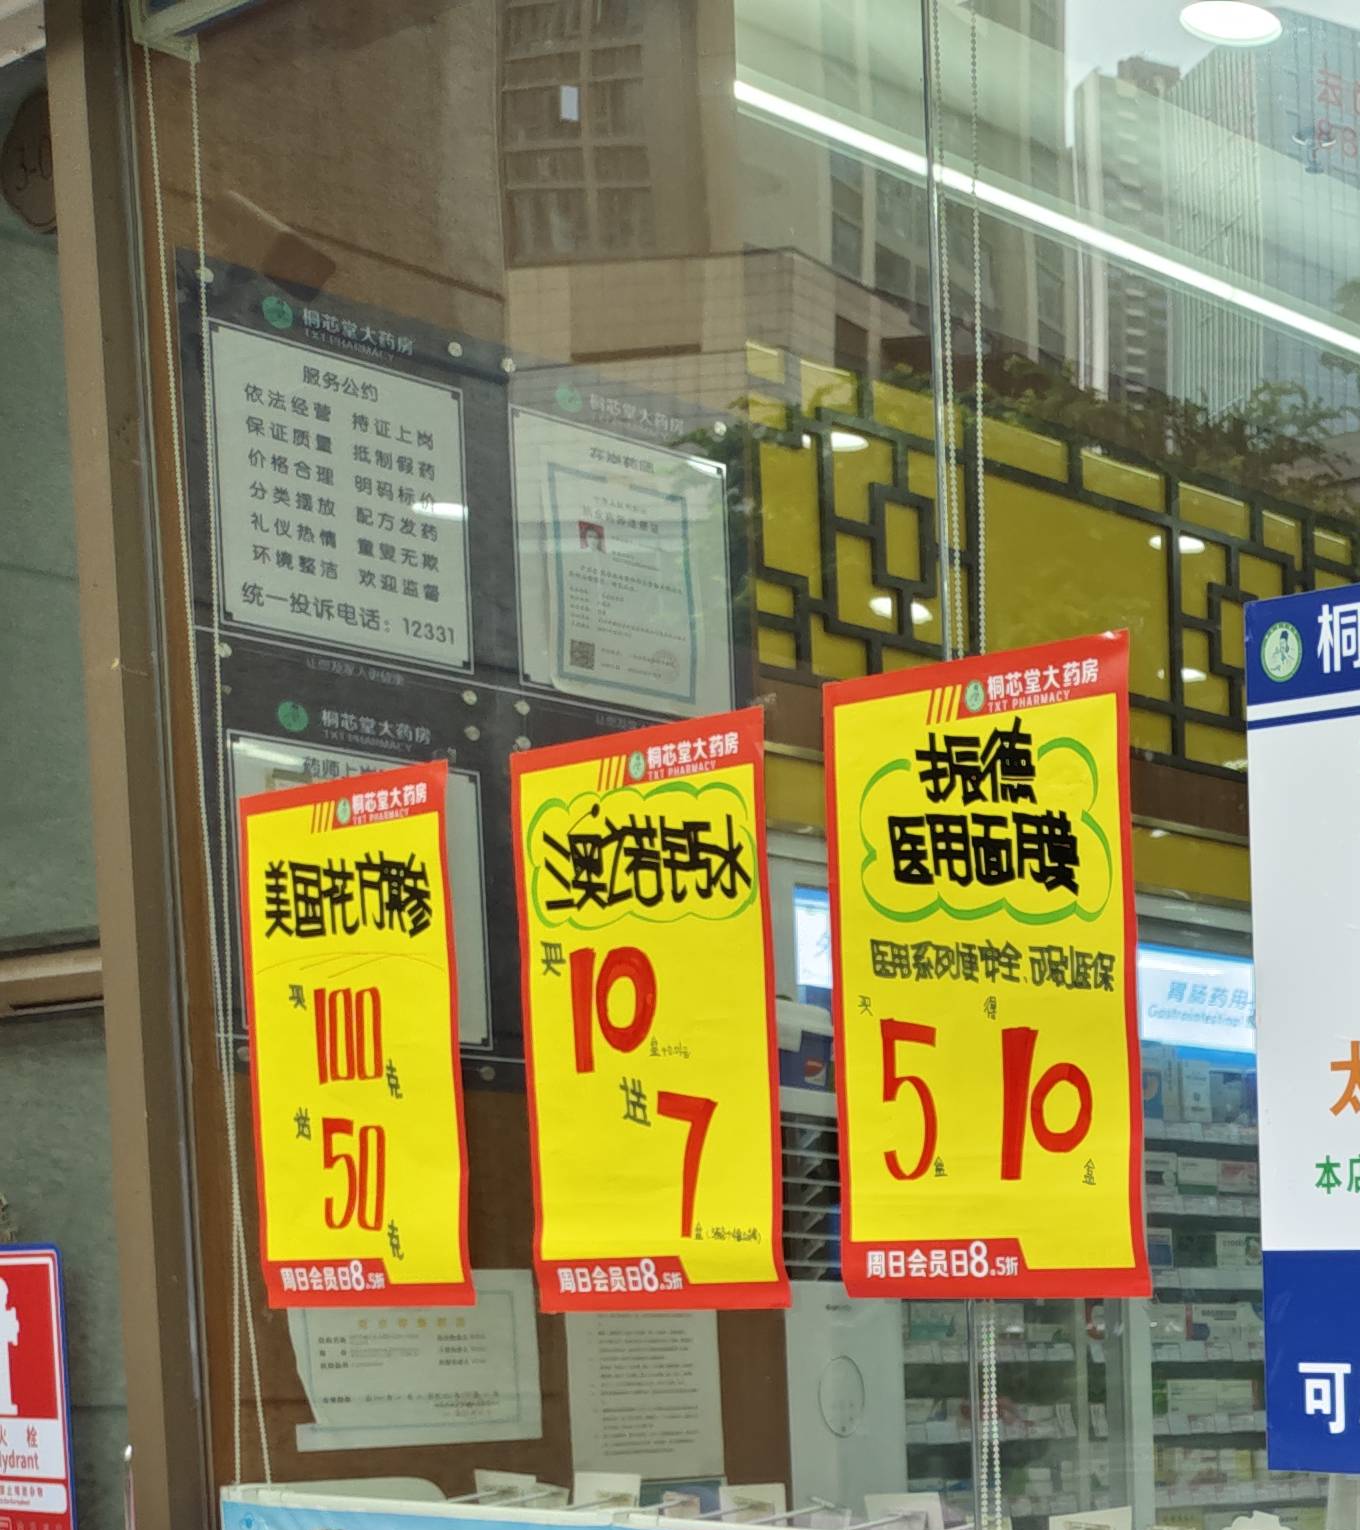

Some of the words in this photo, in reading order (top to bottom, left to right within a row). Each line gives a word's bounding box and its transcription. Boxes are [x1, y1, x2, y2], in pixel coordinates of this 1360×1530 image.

[303, 365, 379, 403] 服务公约
[244, 382, 332, 423] 依法经营
[352, 412, 434, 451] 持证上岗
[245, 415, 333, 454] 保证质量
[353, 444, 435, 482] 抵制假药
[248, 448, 335, 487] 价格合理
[354, 475, 435, 510] 明码标价
[249, 480, 336, 517] 分类摆放
[356, 506, 438, 542] 配方发药
[250, 512, 337, 549] 礼仪热情
[357, 538, 440, 574] 童叟无欺
[252, 544, 338, 580] 环境整洁
[358, 569, 440, 603] 欢迎监督
[402, 617, 455, 645] 12331
[987, 659, 1099, 699] 桐芯堂大药房
[1011, 690, 1070, 710] PHARMACY
[647, 732, 739, 769] 桐芯堂大药房
[915, 716, 1037, 807] 振德
[352, 782, 428, 814] 桐芯堂大药房
[887, 809, 1080, 897] 医用面膜
[569, 946, 658, 1073] 10
[880, 1018, 938, 1181] 5
[1001, 1026, 1093, 1181] 10
[322, 1117, 386, 1232] 50
[657, 1090, 718, 1238] 7
[279, 1260, 386, 1292] 周日会员日8.5折
[557, 1258, 683, 1293] 周日会员日8.5折
[866, 1240, 1019, 1279] 周日会员日8.5折
